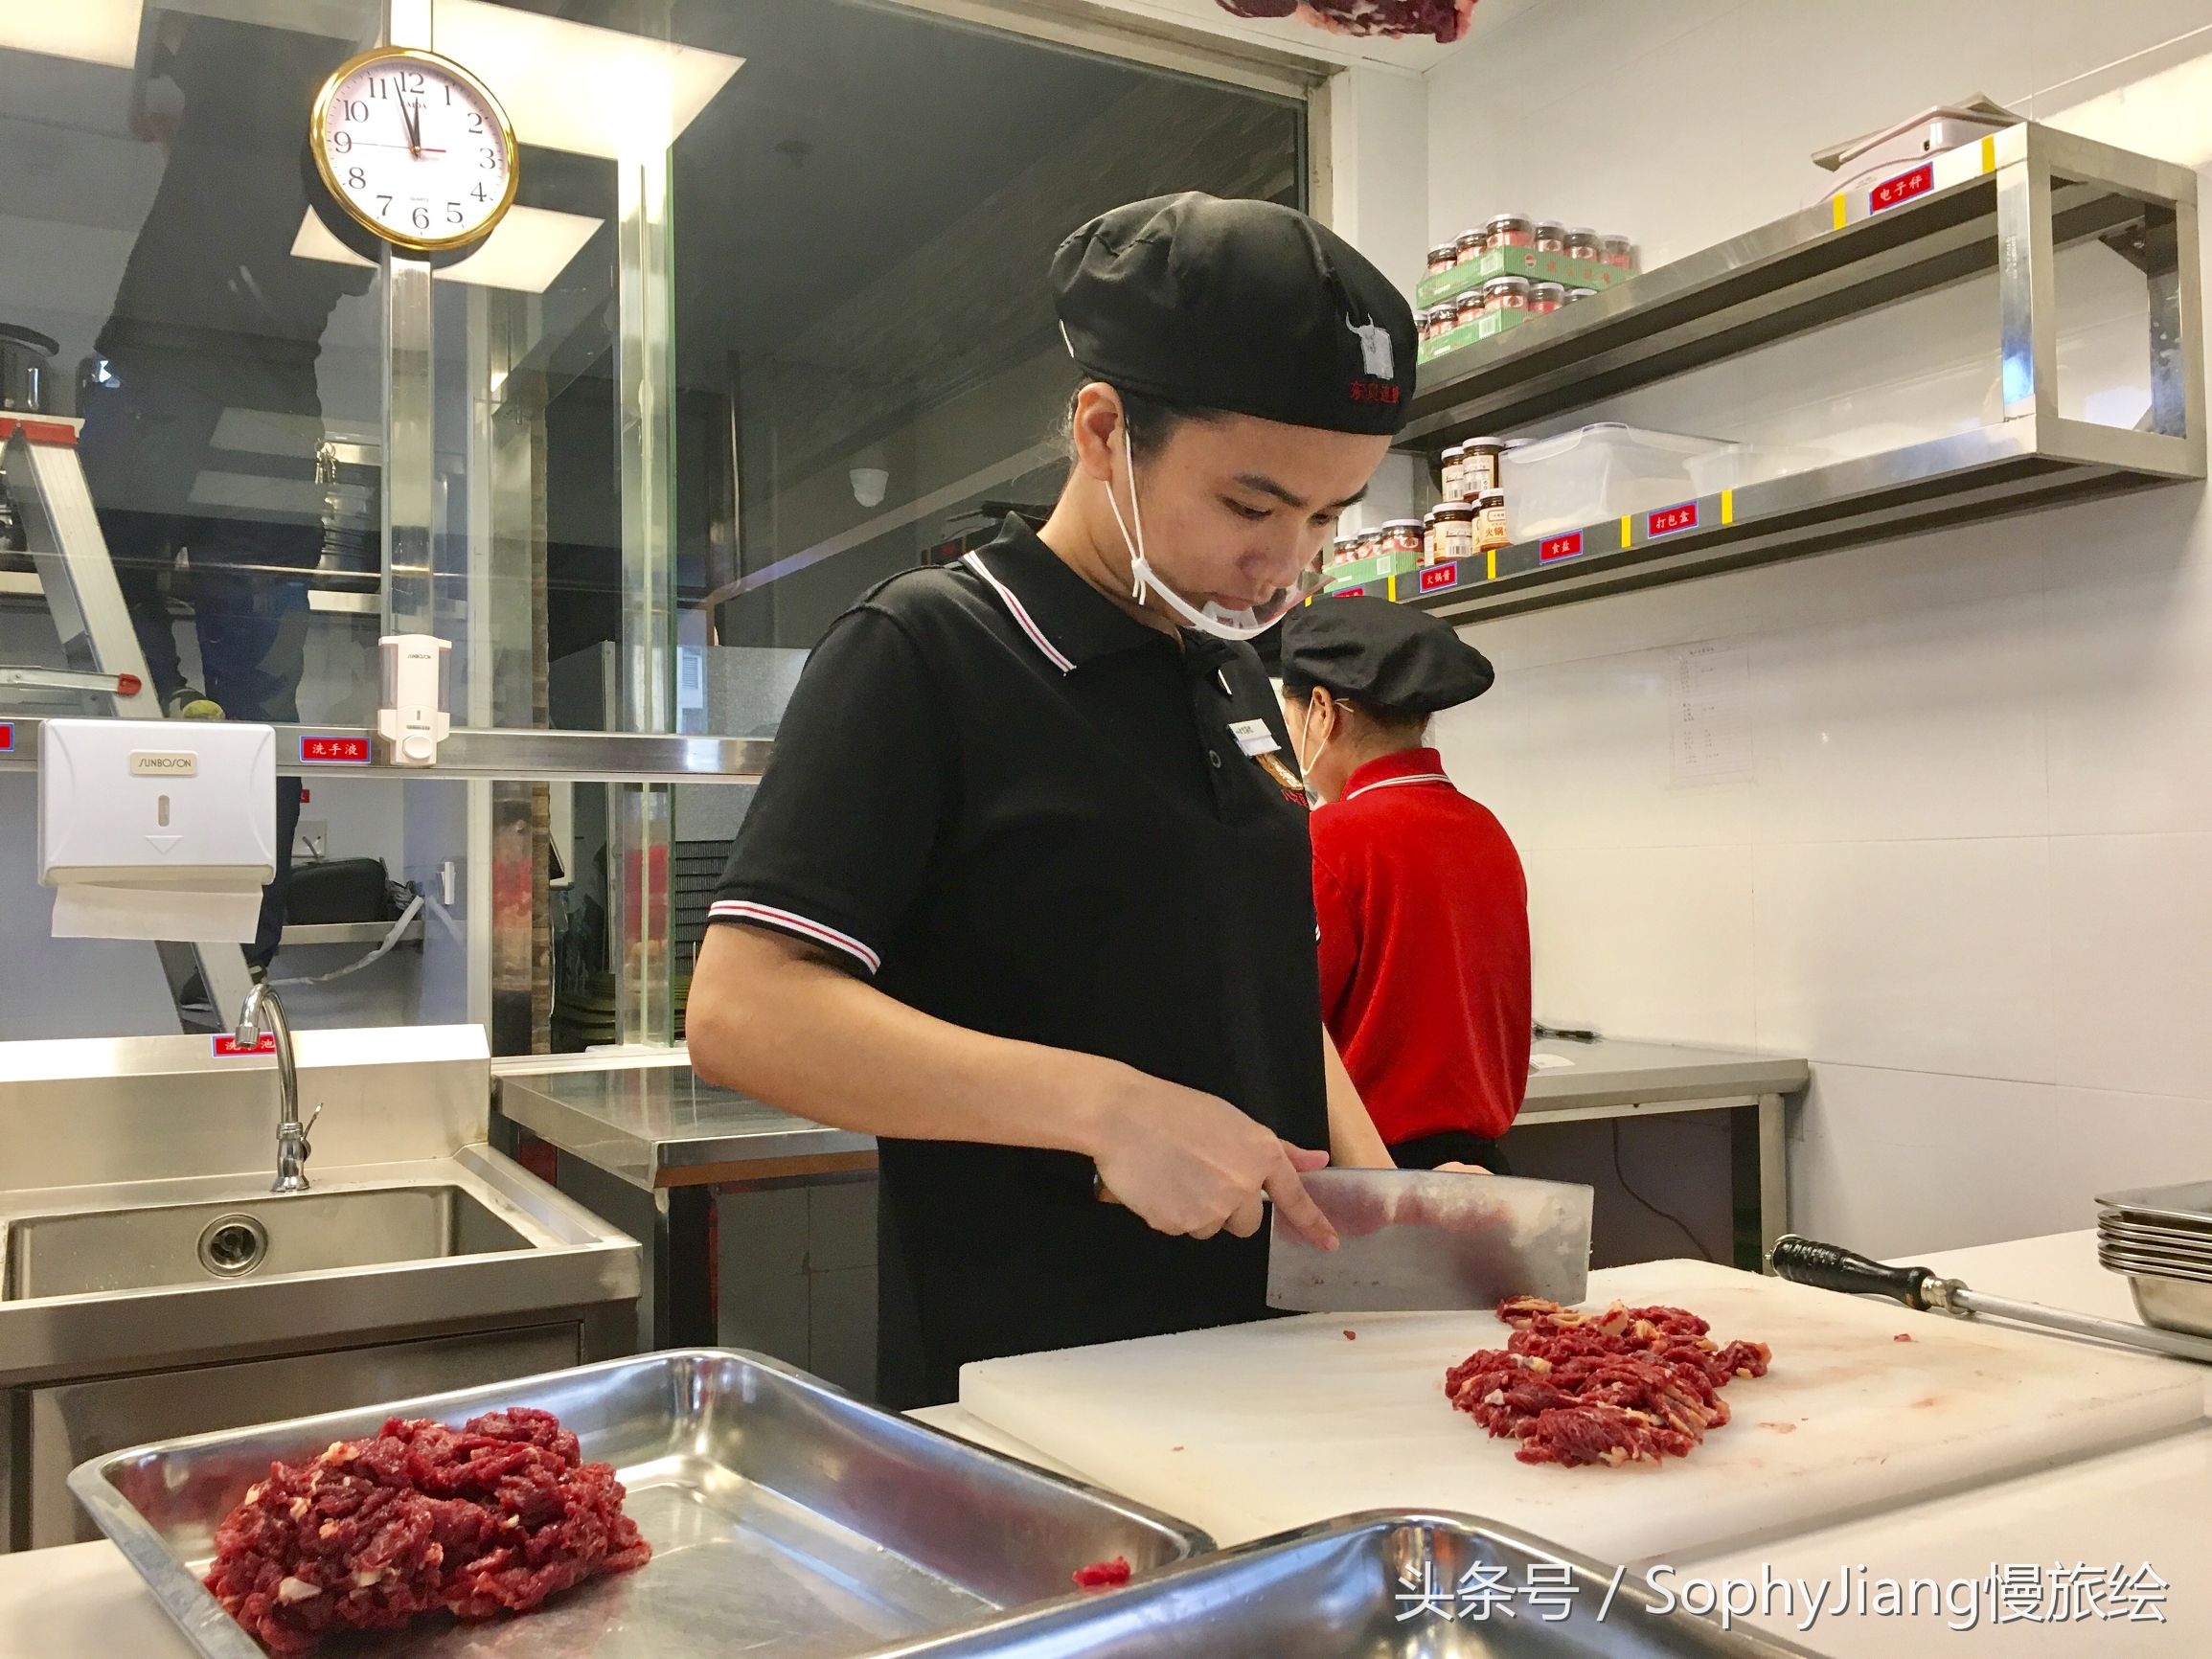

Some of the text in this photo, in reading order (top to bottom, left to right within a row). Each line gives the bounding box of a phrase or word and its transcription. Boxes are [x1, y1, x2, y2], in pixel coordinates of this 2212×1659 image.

[369, 78, 387, 100] 11
[399, 71, 424, 94] 12
[445, 84, 450, 105] 1
[343, 100, 369, 123] 10
[467, 112, 483, 134] 2
[333, 131, 352, 153] 9
[479, 148, 496, 170] 3
[348, 167, 366, 190] 8
[1880, 174, 1923, 201] 电子秤
[470, 182, 487, 202] 4
[376, 194, 393, 216] 7
[446, 201, 463, 223] 5
[412, 207, 429, 229] 6
[1655, 511, 1690, 530] 打包盒
[1552, 541, 1571, 554] 食盐
[312, 742, 358, 756] 洗手液
[138, 758, 192, 768] SUNBOSON
[224, 1038, 275, 1051] 洗池
